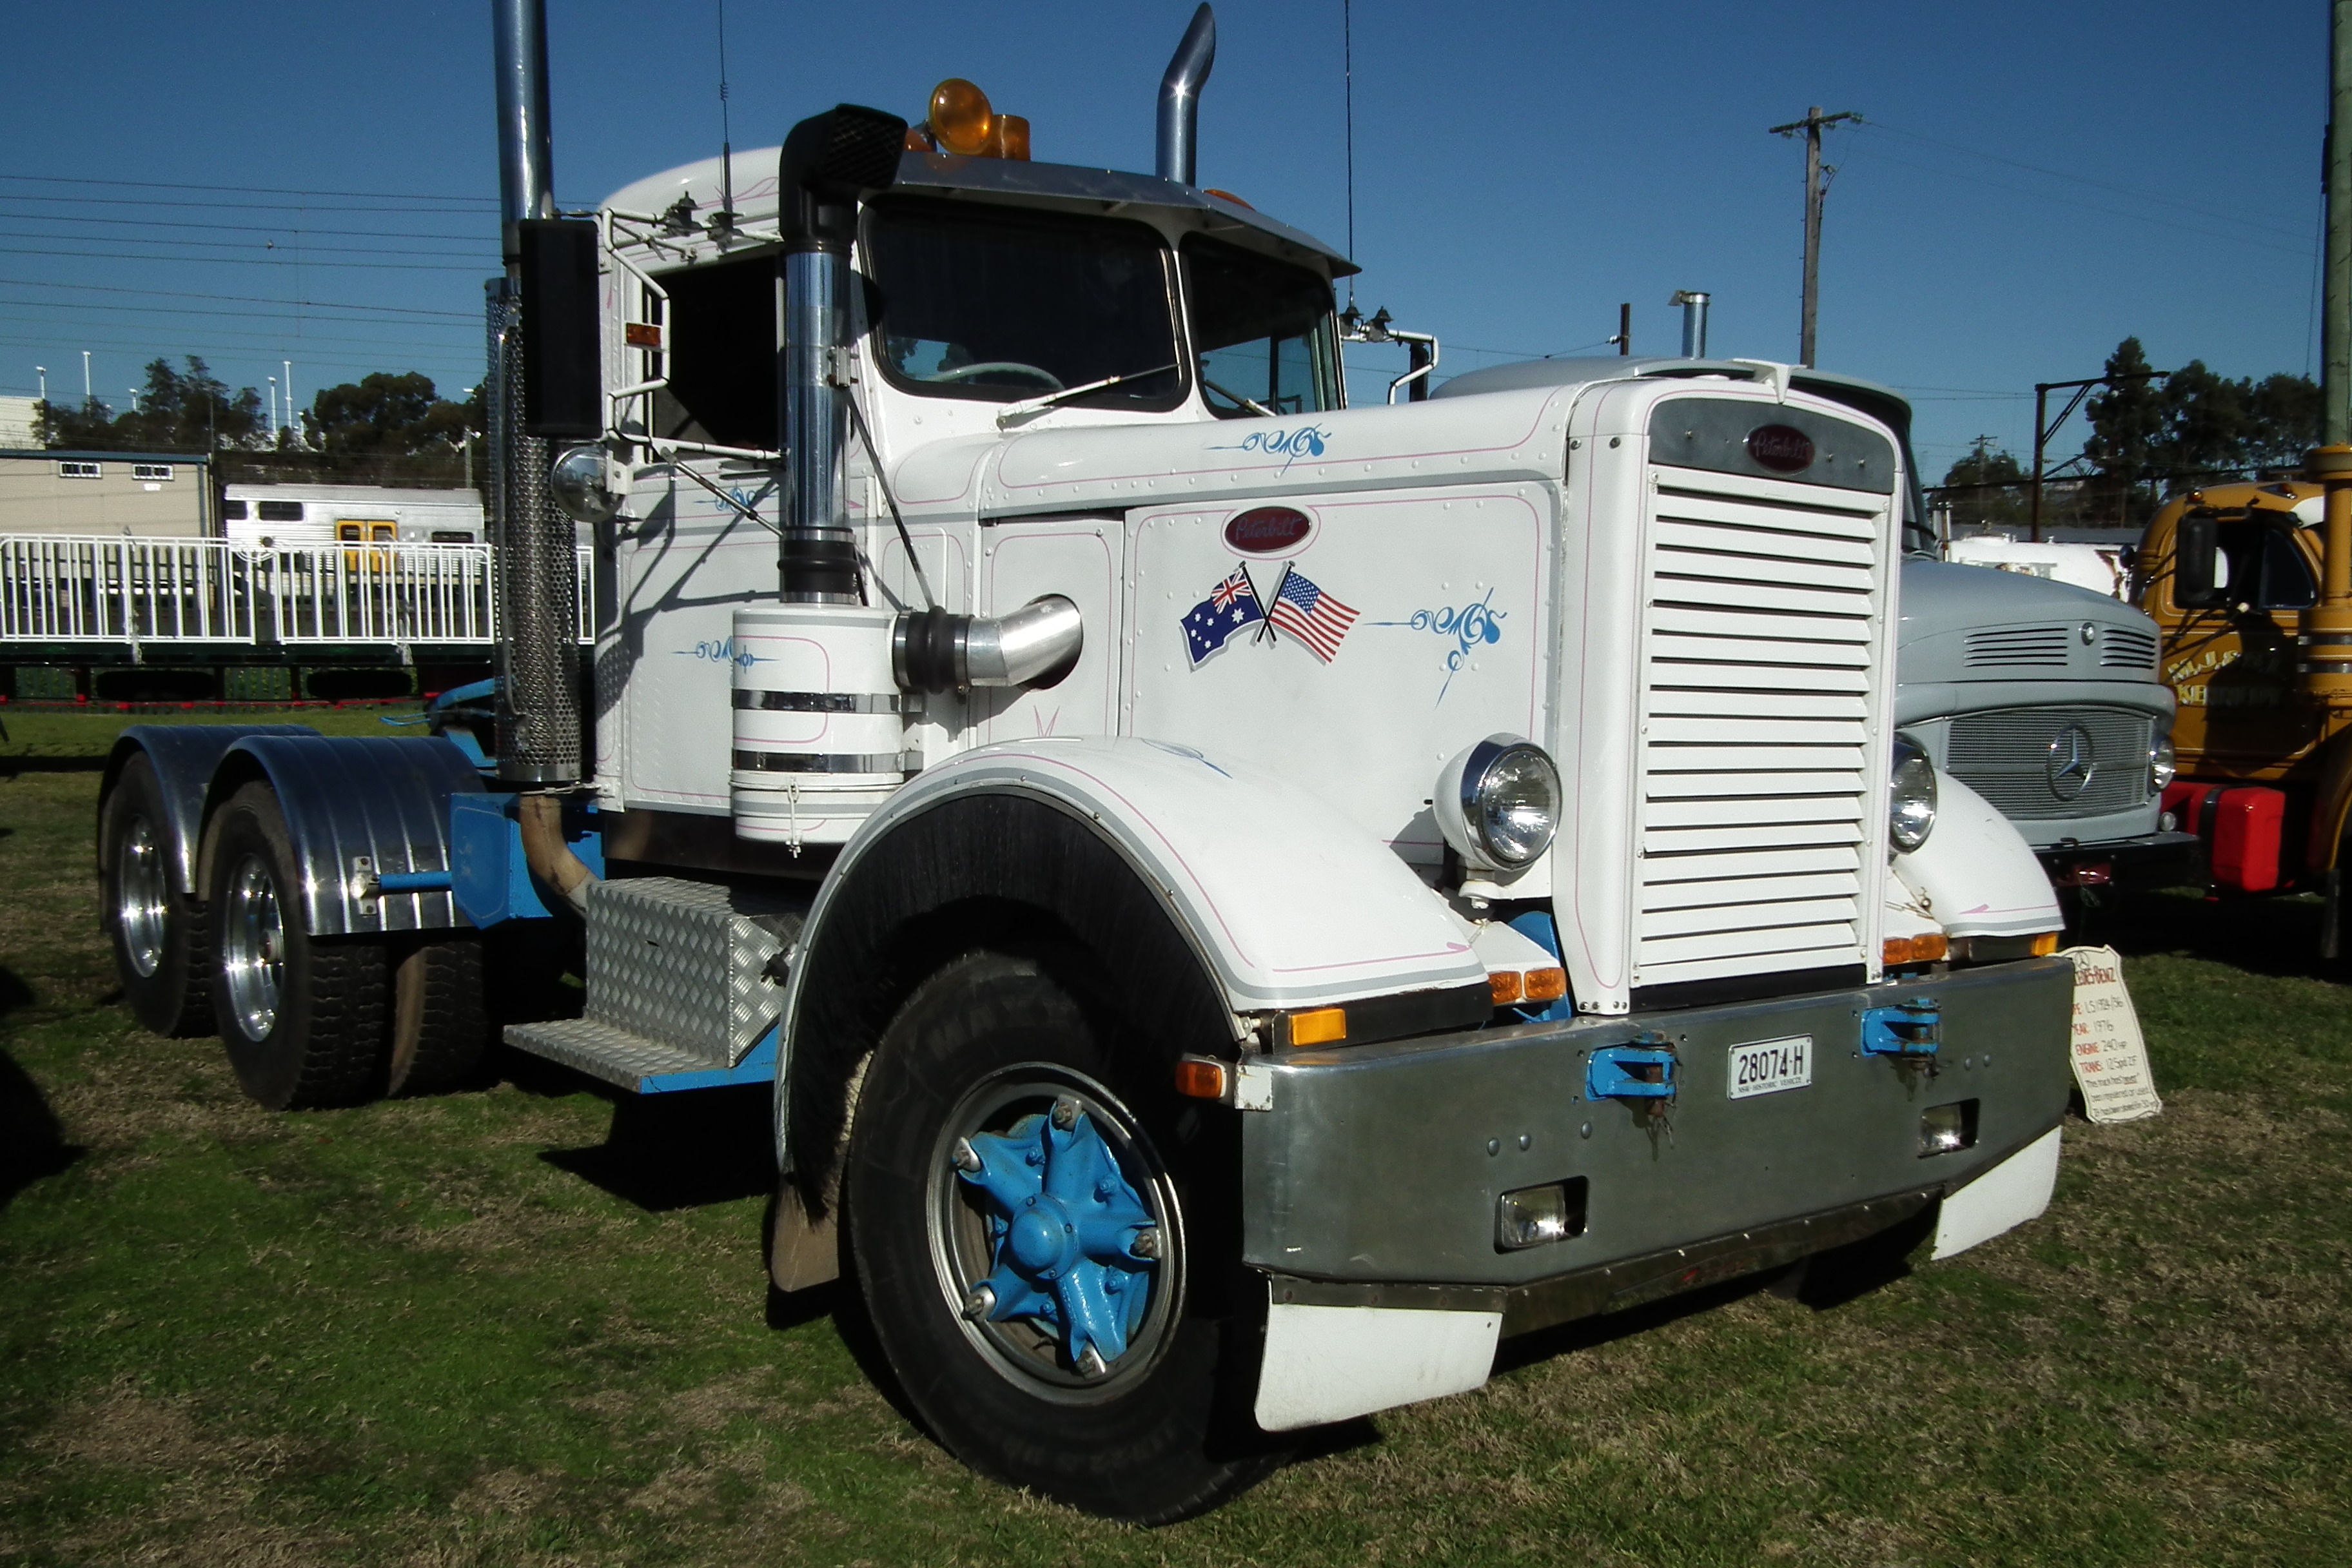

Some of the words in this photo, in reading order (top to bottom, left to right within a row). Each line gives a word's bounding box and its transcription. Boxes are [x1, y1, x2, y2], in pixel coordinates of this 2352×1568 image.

[1753, 431, 1808, 459] Peterbilt
[1236, 516, 1302, 540] Peterbilt
[2093, 1019, 2113, 1032] 1976
